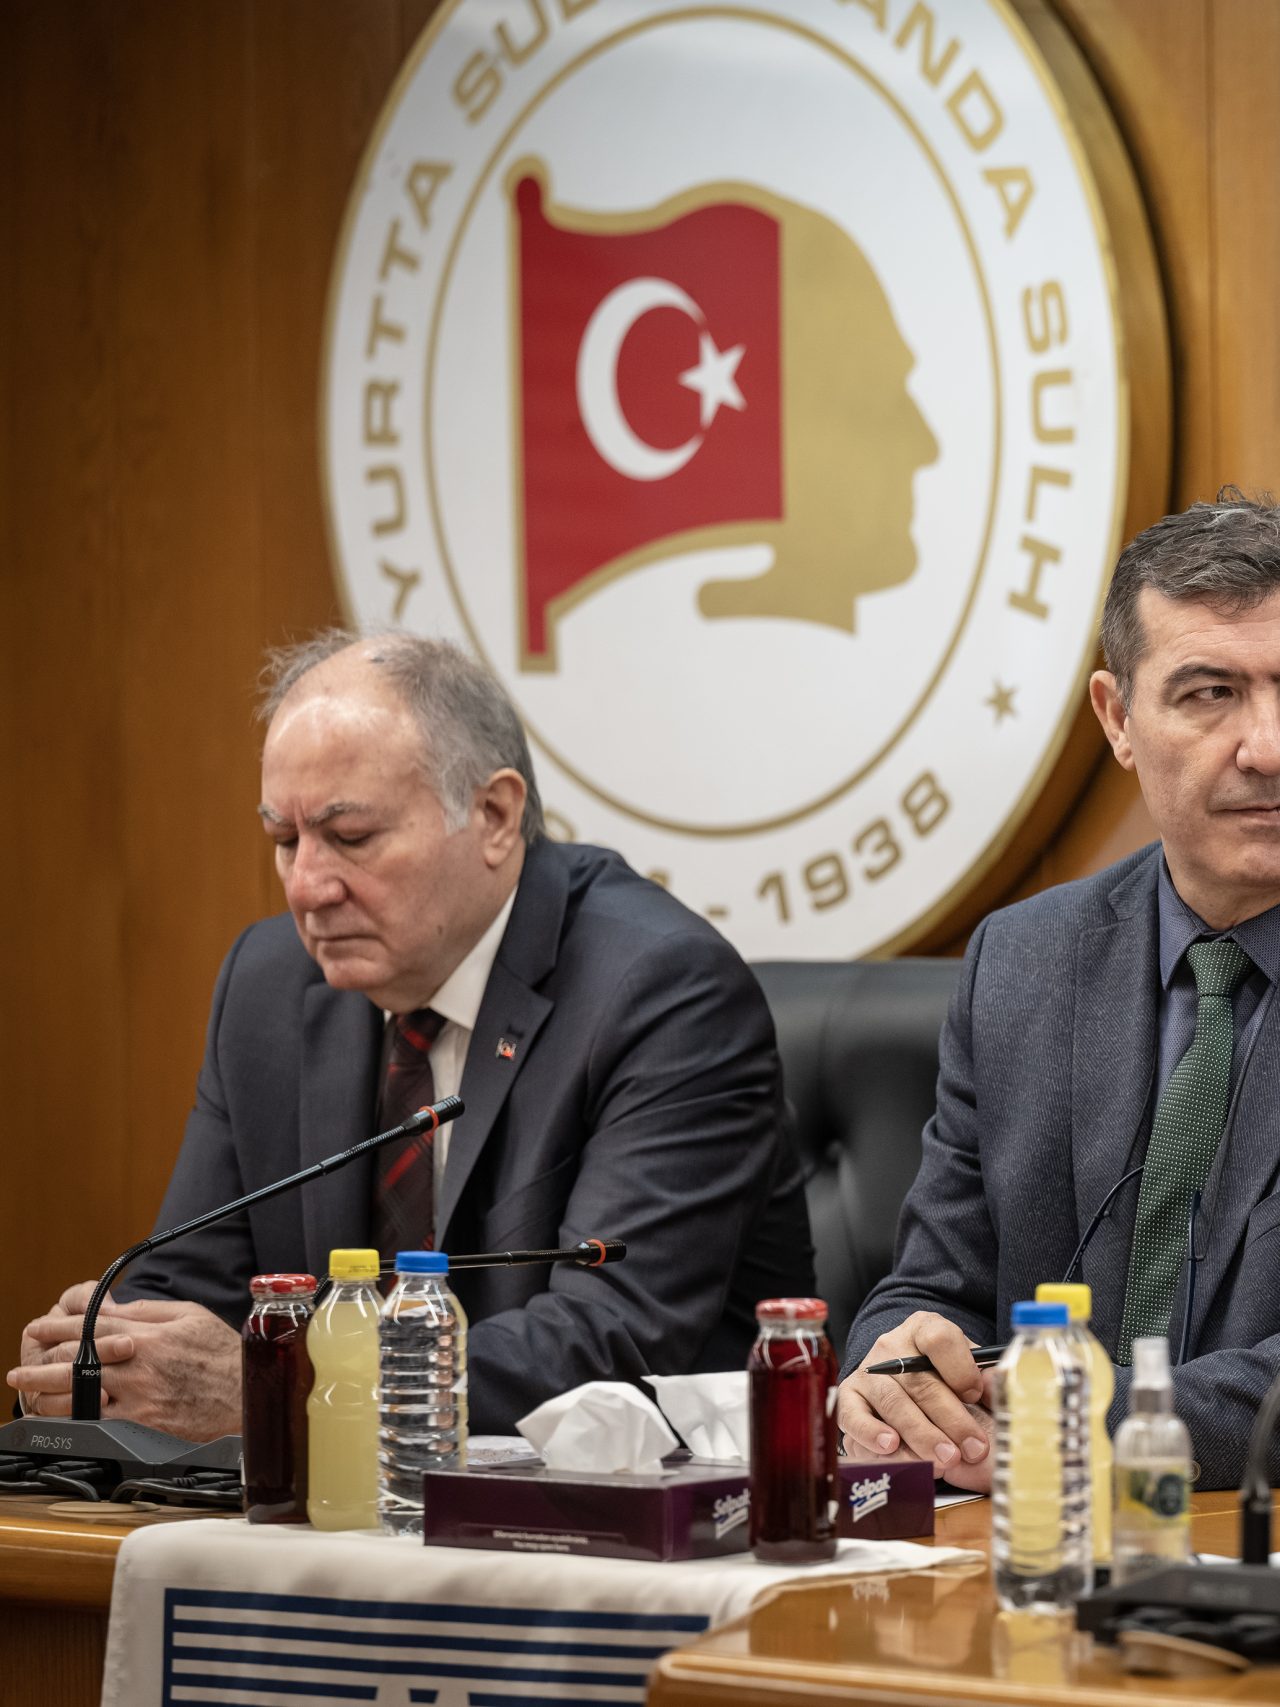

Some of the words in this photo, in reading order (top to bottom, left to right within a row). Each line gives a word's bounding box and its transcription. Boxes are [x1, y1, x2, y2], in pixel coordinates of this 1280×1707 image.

[364, 159, 455, 620] YURTTA
[1006, 279, 1076, 622] SULH
[758, 769, 950, 925] 1938
[31, 1435, 72, 1449] PRO-SYS
[850, 1473, 891, 1502] Selpak
